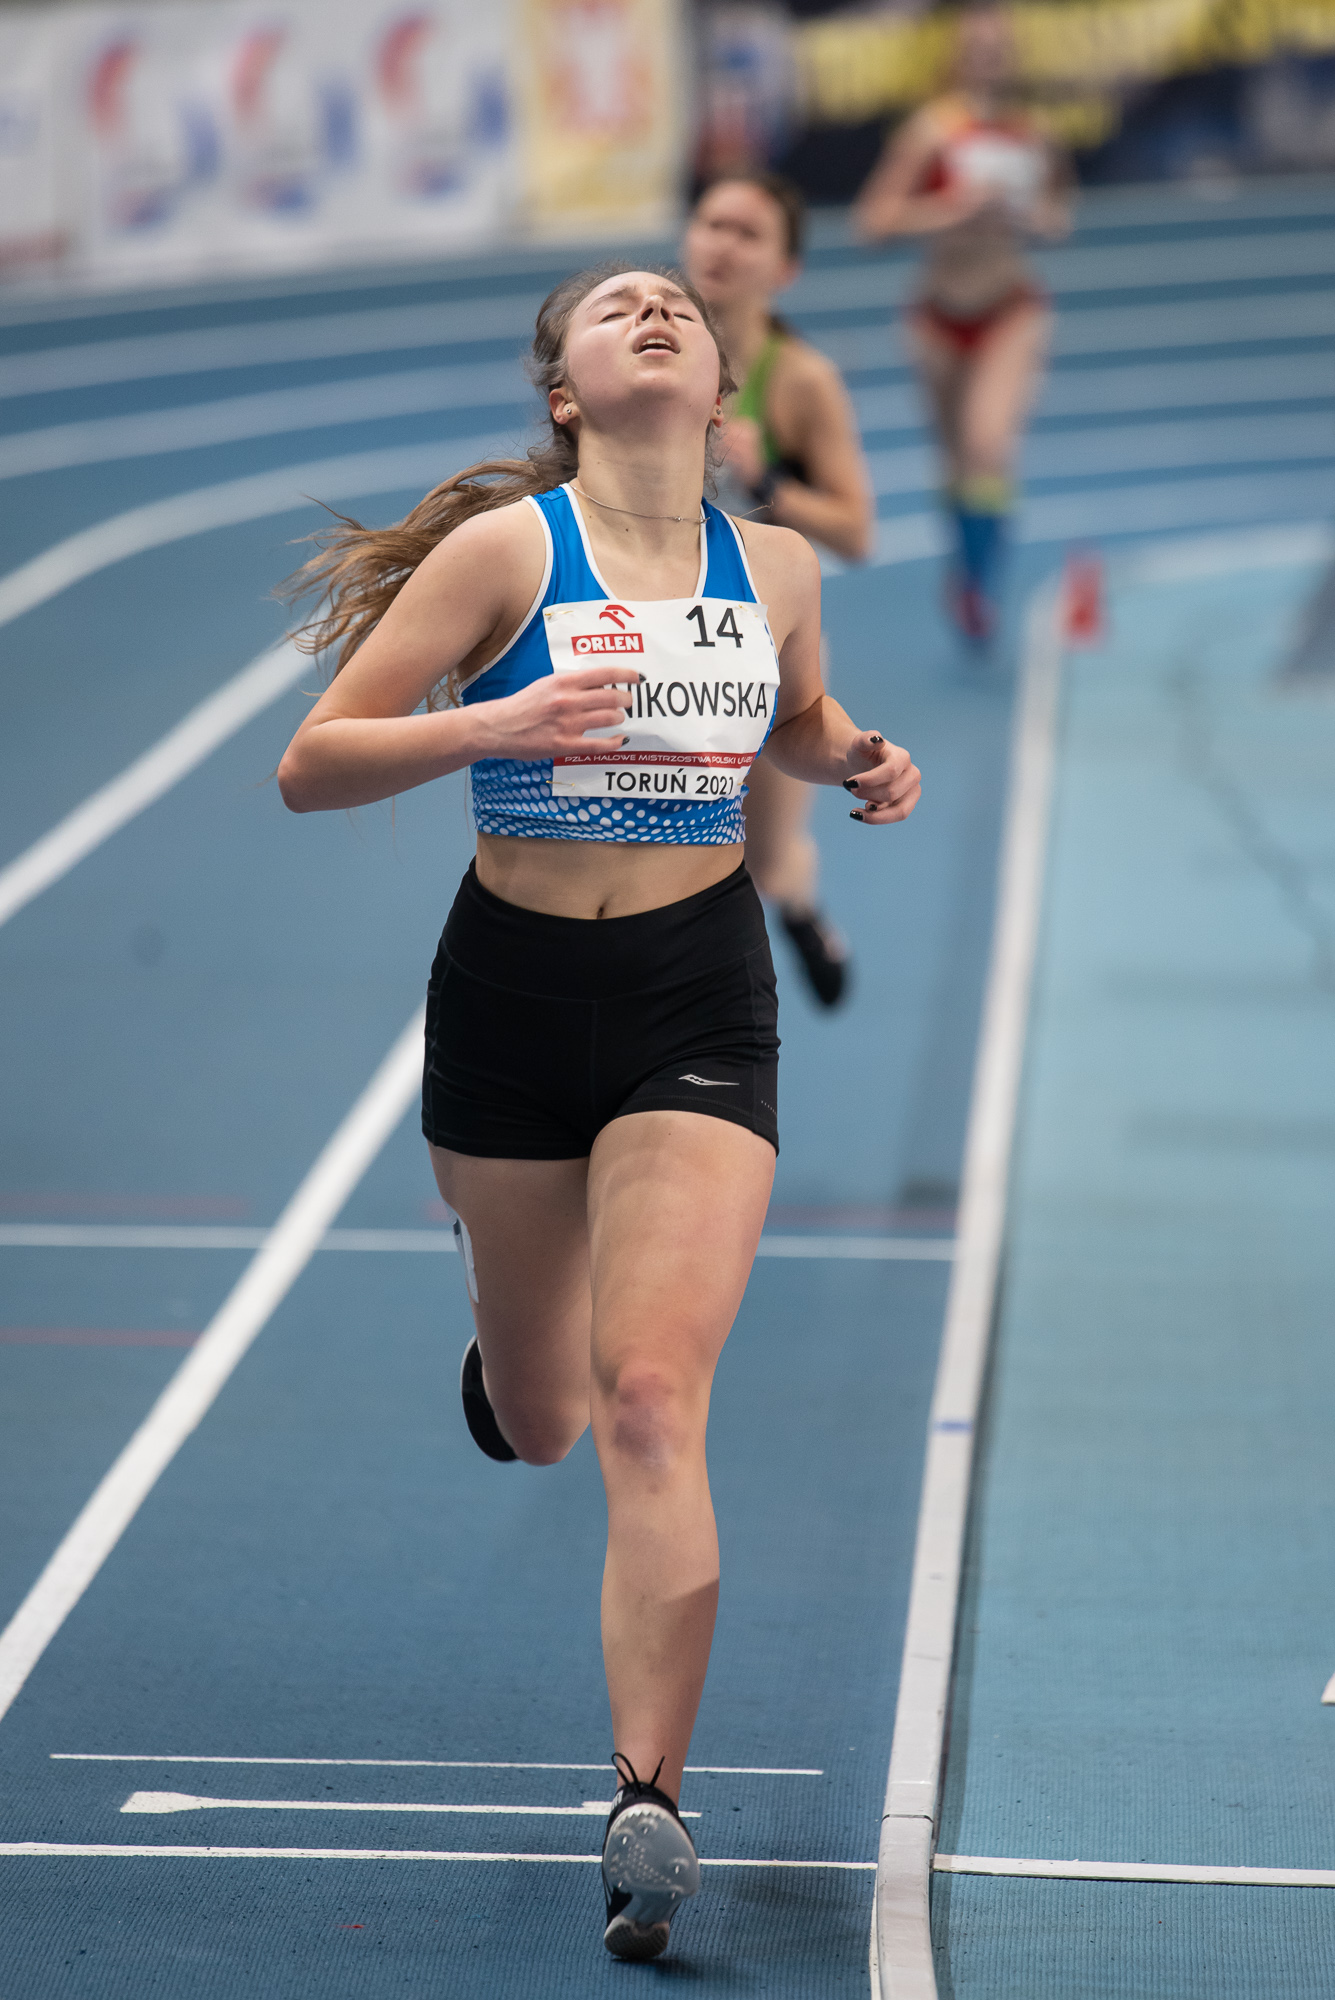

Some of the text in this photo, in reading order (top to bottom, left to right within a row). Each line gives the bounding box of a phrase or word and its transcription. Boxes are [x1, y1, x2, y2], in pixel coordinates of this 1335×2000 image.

[685, 604, 744, 649] 14
[575, 635, 639, 653] ORLEN
[602, 681, 767, 718] IKOWSKA
[564, 755, 591, 763] PZLA
[637, 754, 711, 764] MISTRZOSTWA
[711, 756, 736, 764] POLSKI
[605, 768, 734, 795] TORUŃ 2021
